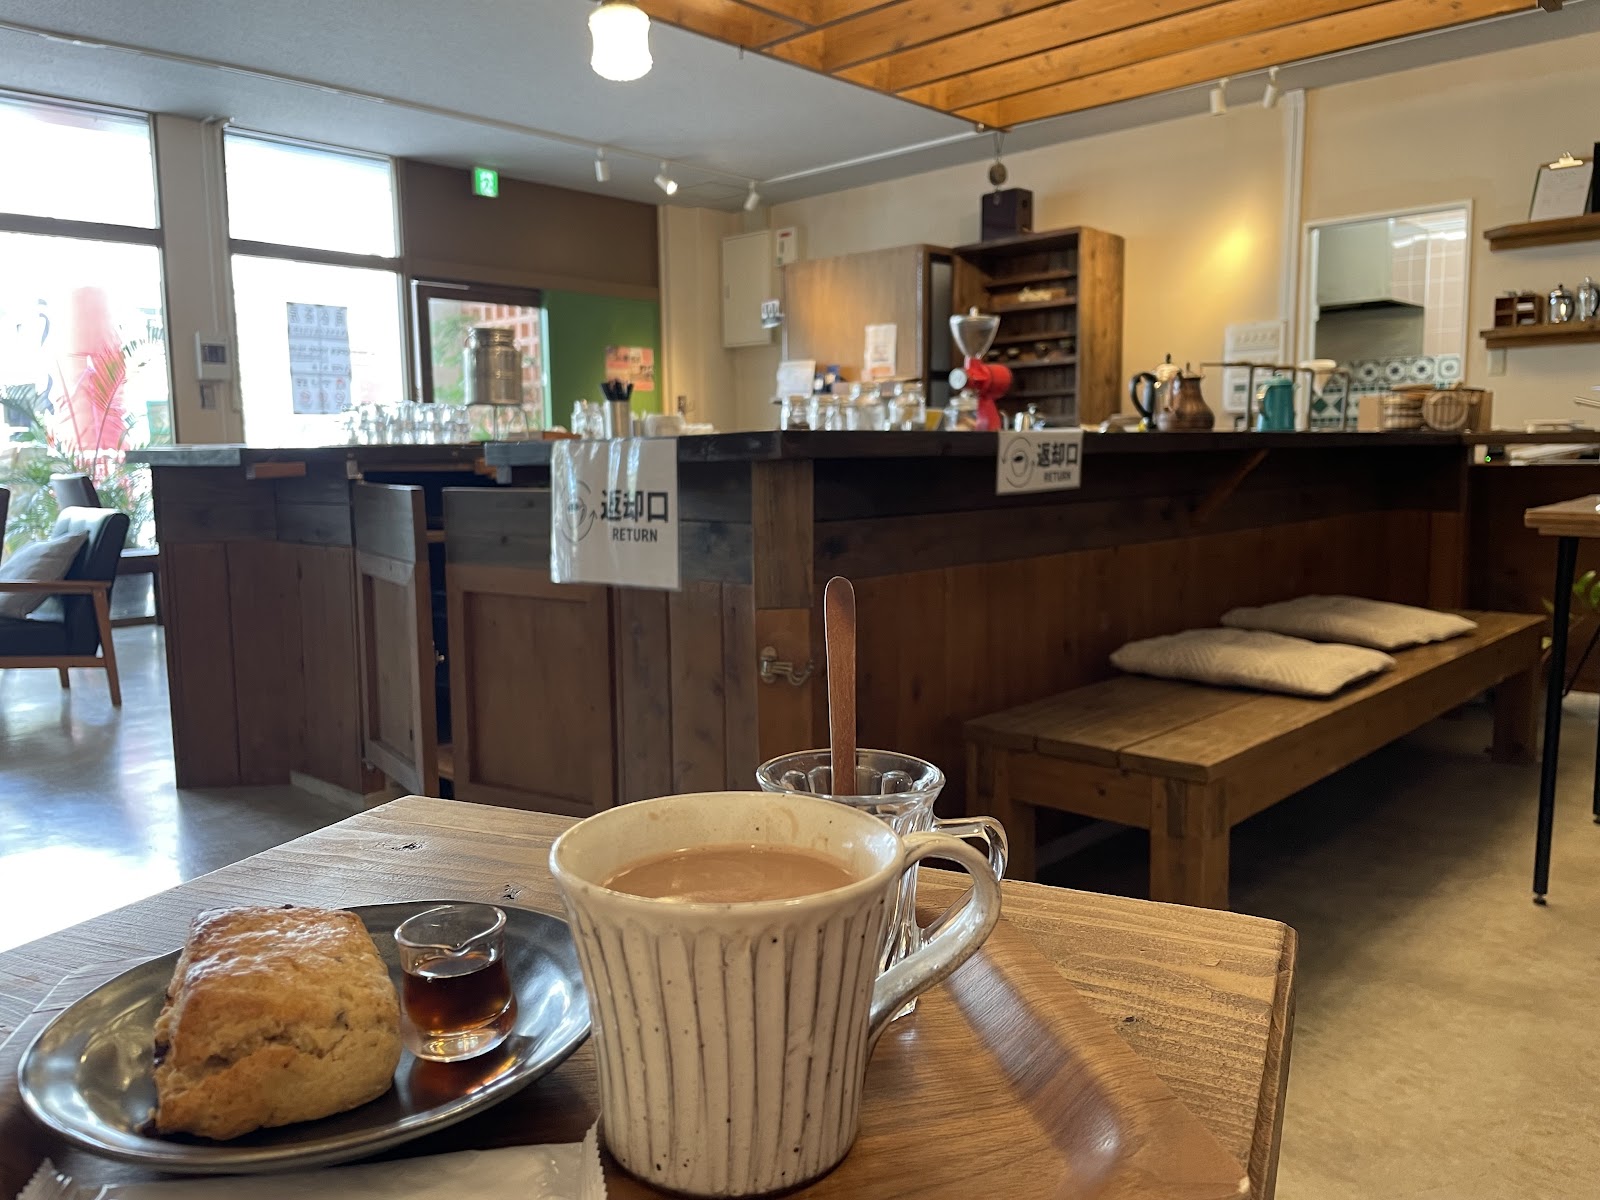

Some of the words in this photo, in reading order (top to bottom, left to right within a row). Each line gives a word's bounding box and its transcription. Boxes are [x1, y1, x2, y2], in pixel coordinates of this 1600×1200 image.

[1037, 442, 1079, 467] 返却口
[1044, 471, 1071, 483] RETURN
[600, 489, 669, 524] 返却口
[612, 528, 658, 542] RETURN
